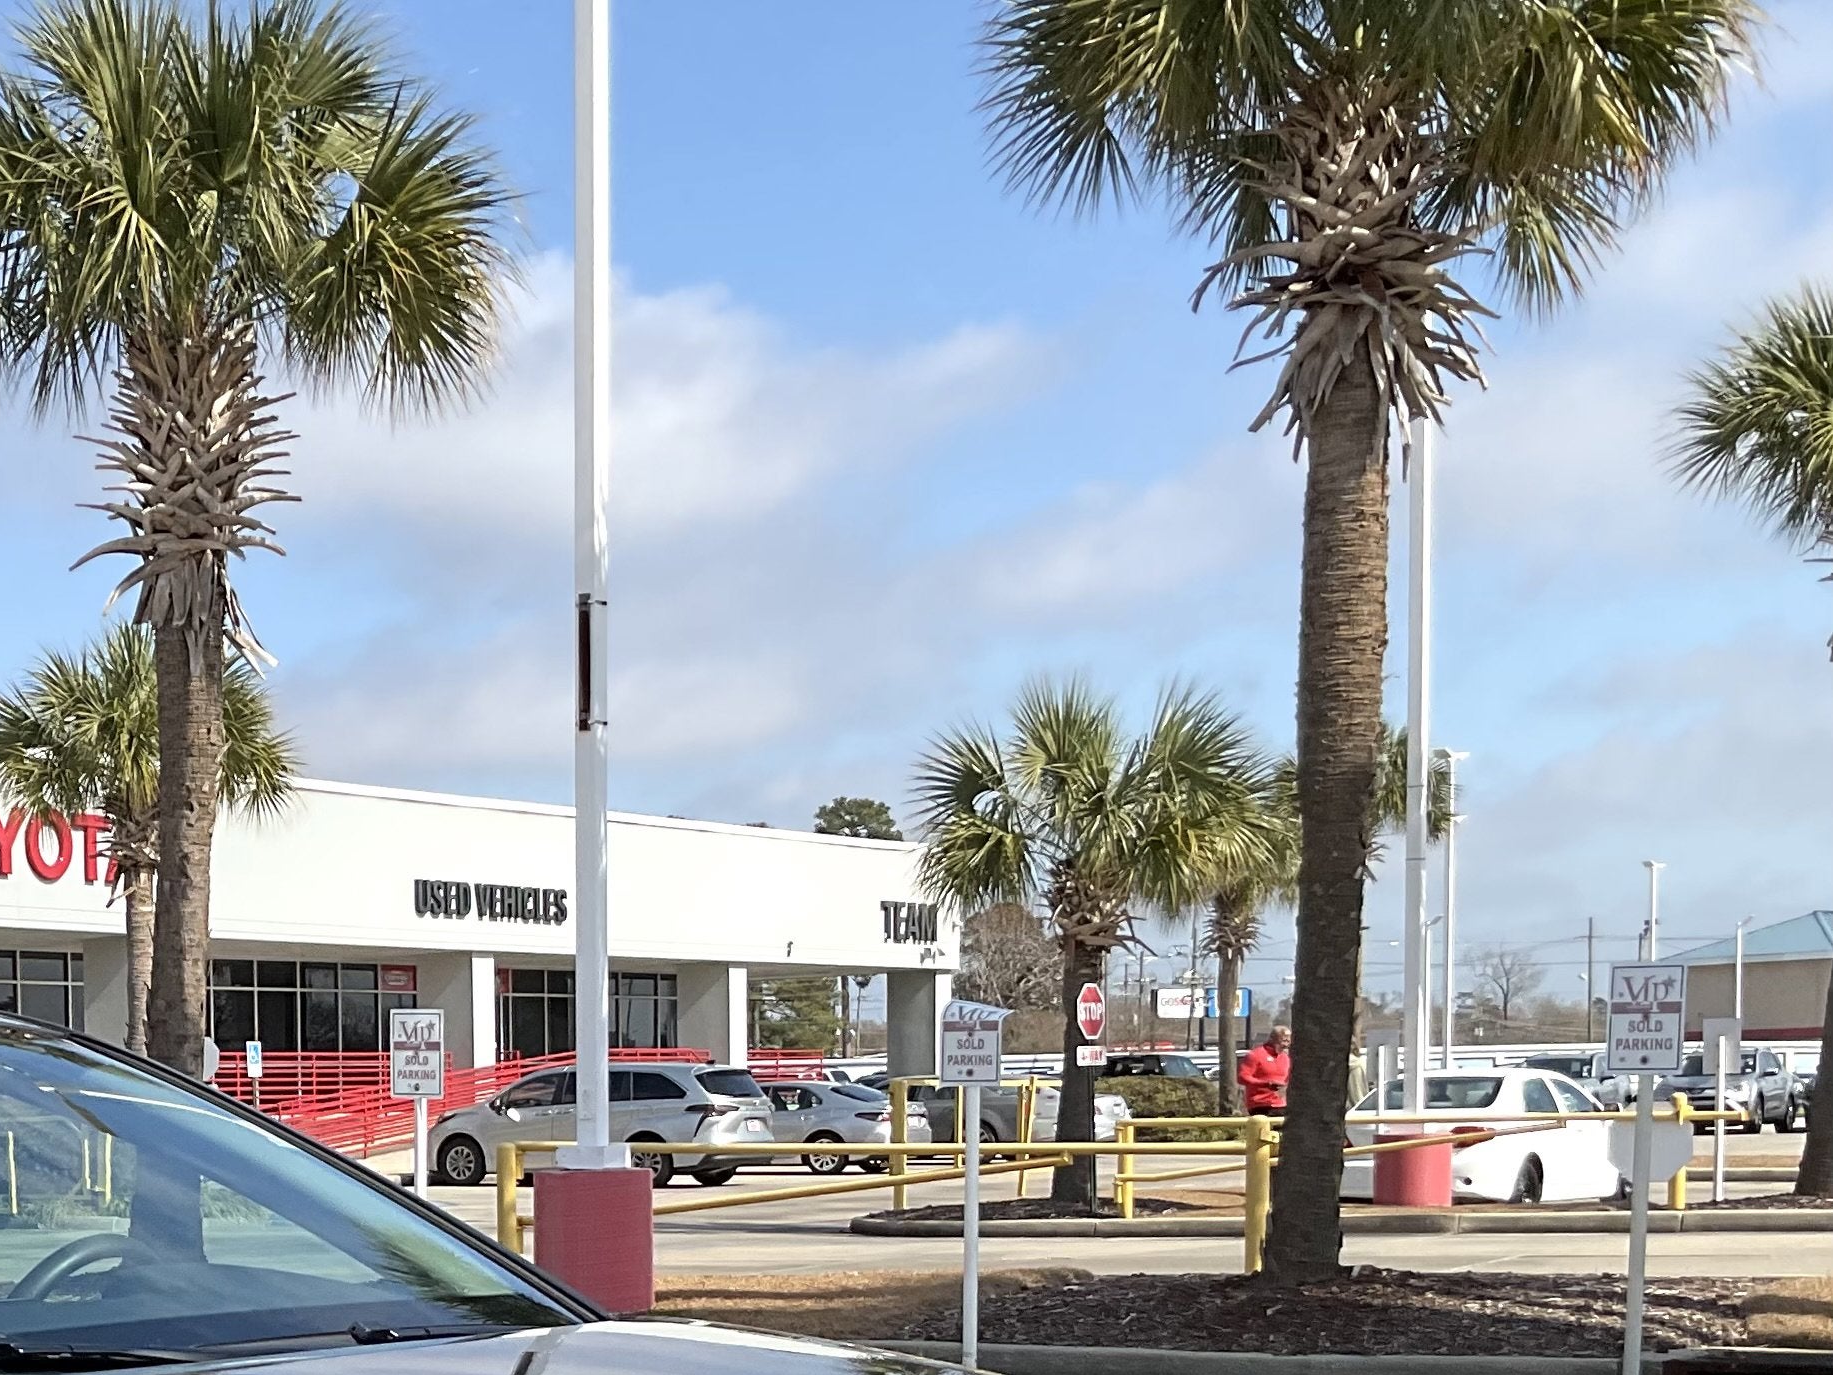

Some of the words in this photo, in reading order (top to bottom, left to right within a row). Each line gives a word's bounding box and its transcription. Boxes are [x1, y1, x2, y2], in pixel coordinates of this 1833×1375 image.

[414, 879, 471, 919] USED
[474, 884, 568, 926] VEHICLES
[880, 901, 938, 943] TEAM
[1079, 1002, 1103, 1021] STOP
[1628, 1020, 1663, 1033] SOLD
[956, 1038, 985, 1050] SOLD
[1615, 1038, 1673, 1051] PARKING
[404, 1055, 429, 1066] SOLD
[946, 1054, 993, 1066] PARKING
[397, 1069, 437, 1080] PARKING
